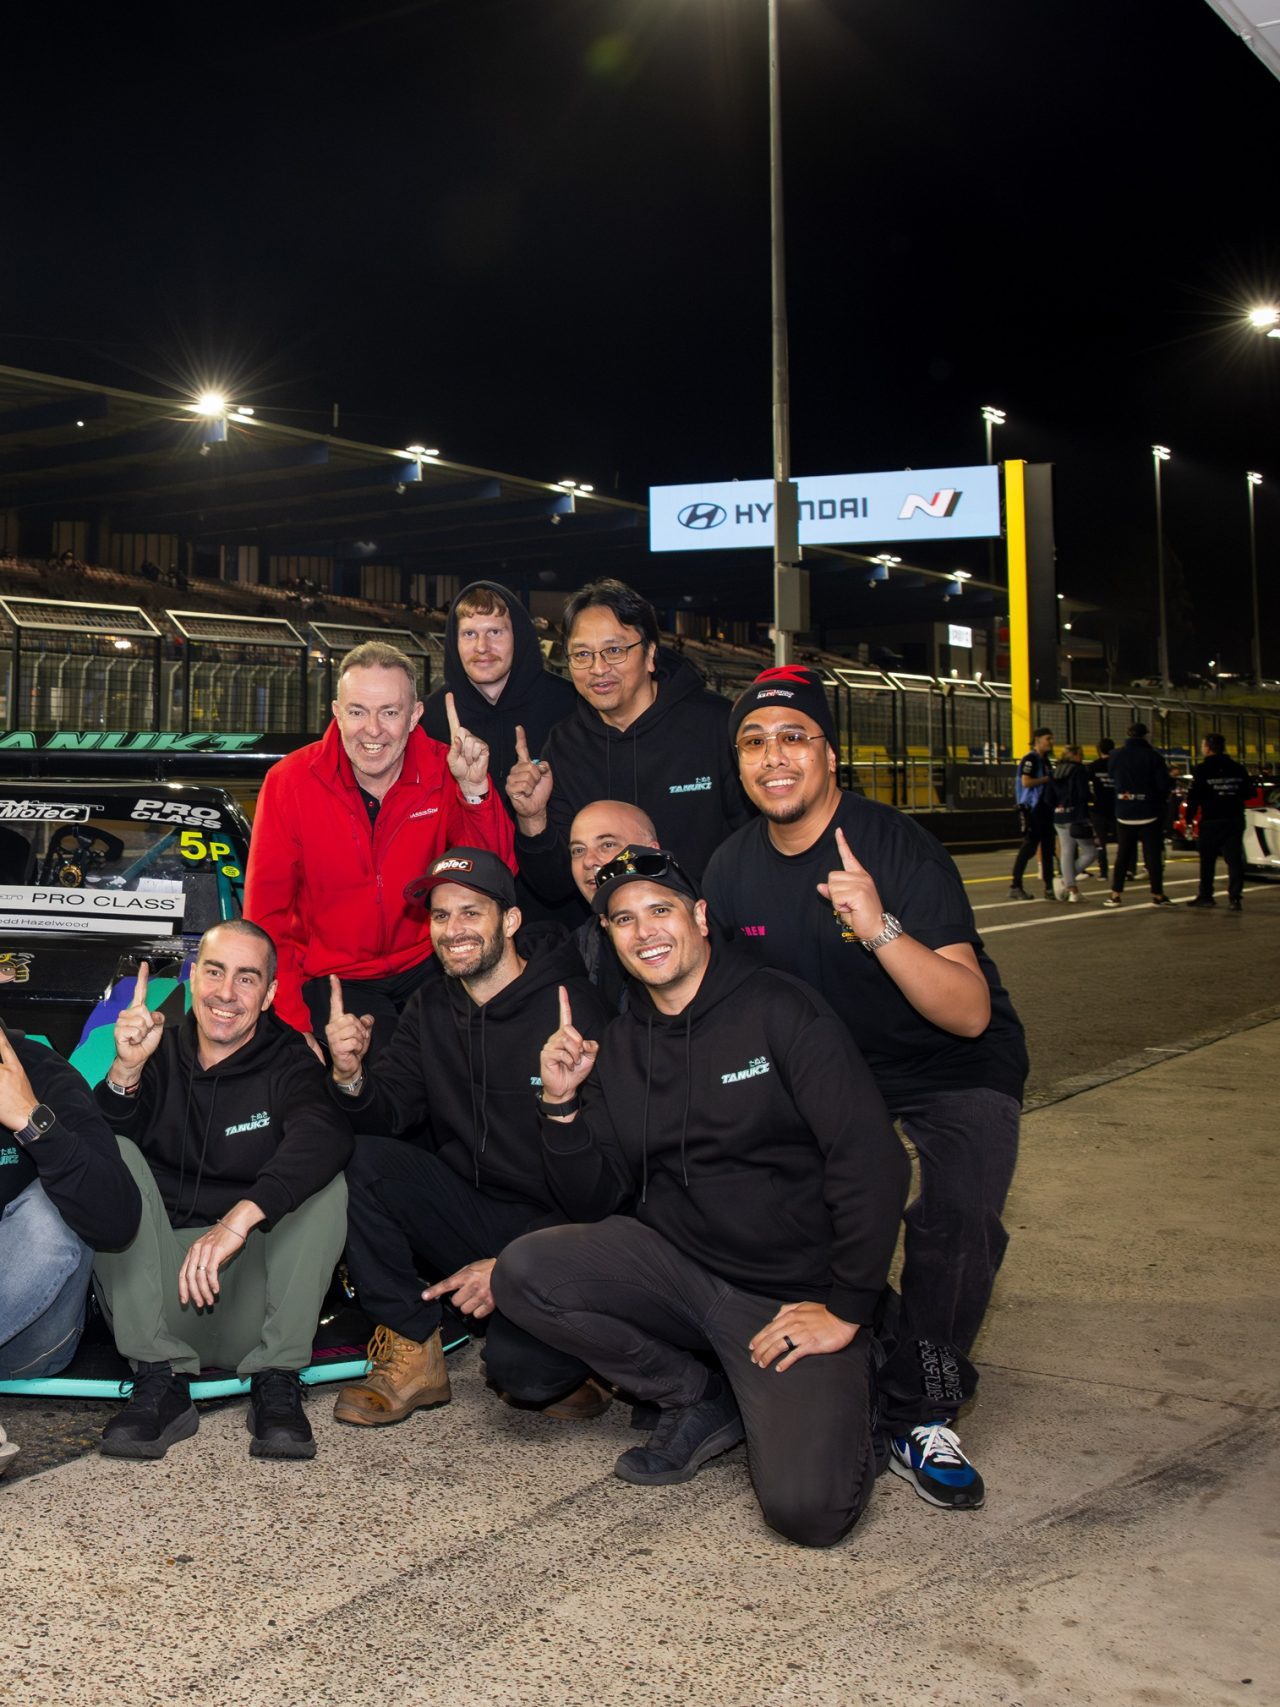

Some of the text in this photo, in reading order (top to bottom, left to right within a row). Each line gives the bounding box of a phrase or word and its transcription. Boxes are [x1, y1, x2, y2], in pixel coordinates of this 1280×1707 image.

[736, 497, 868, 524] HYNDAI
[133, 799, 221, 820] PRO
[130, 811, 222, 829] CLASS
[31, 892, 85, 905] PRO
[93, 895, 176, 910] CLASS
[21, 918, 89, 928] Hazelwood
